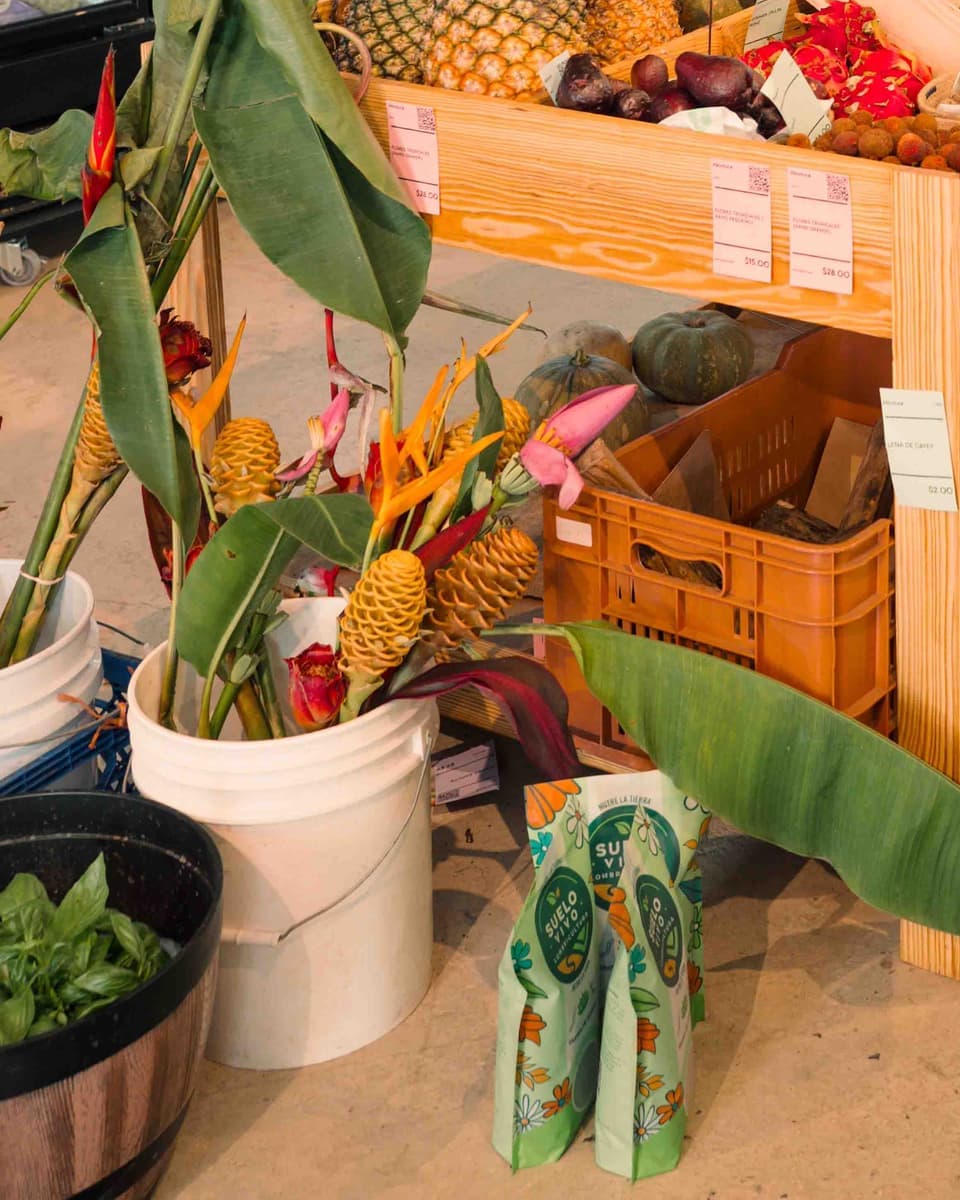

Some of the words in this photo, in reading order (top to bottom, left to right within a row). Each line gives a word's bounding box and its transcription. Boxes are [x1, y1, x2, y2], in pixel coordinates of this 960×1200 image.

[620, 795, 628, 803] LA
[604, 857, 623, 869] VI
[544, 890, 578, 938] SUELO
[553, 908, 579, 944] VIVO
